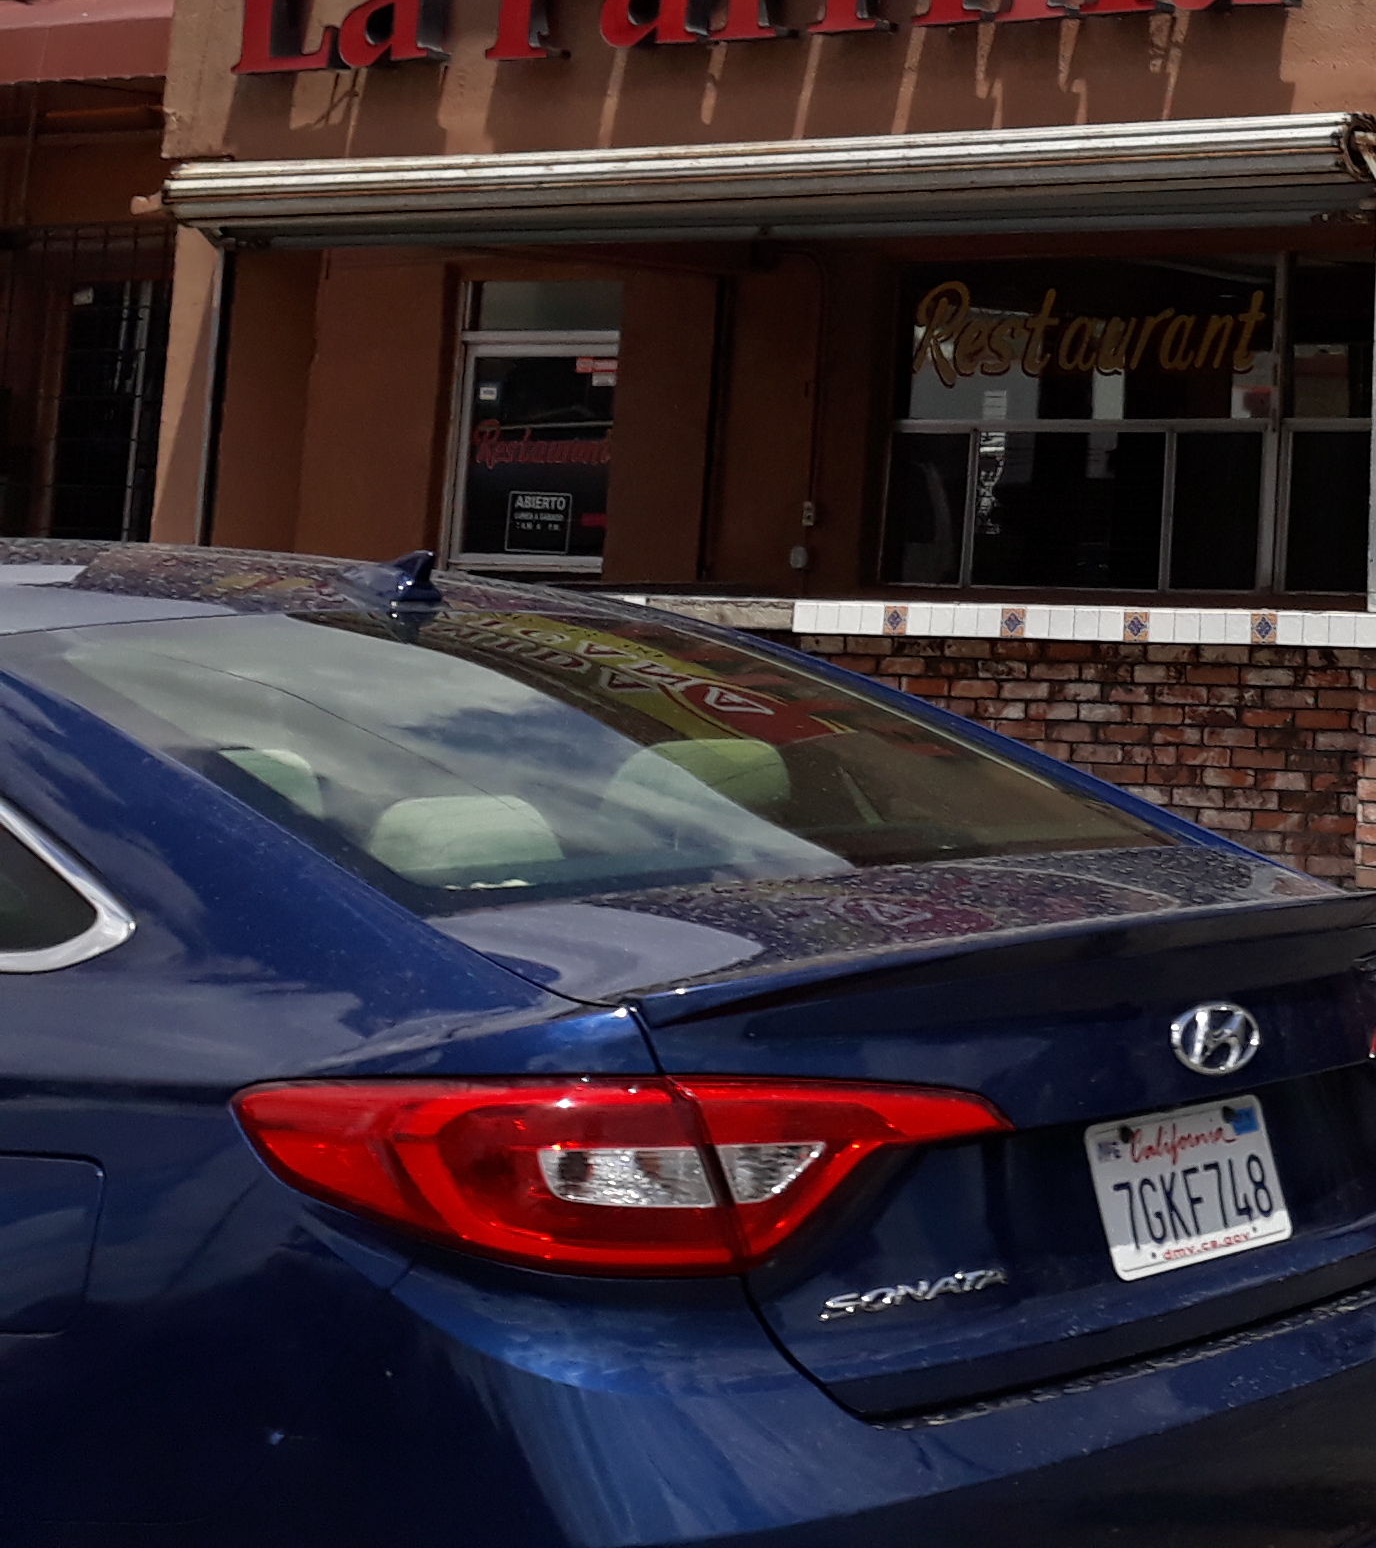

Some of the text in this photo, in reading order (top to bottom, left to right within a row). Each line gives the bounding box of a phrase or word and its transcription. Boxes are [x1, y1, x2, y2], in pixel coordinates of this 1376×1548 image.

[912, 280, 1266, 388] Restaurant
[474, 418, 612, 470] Restaurant
[514, 495, 567, 511] ABIERTO
[1129, 1123, 1237, 1165] California
[1113, 1153, 1274, 1251] 7GKF748
[1163, 1233, 1251, 1261] dmv.ca.gov
[818, 1267, 1009, 1323] SONATA
